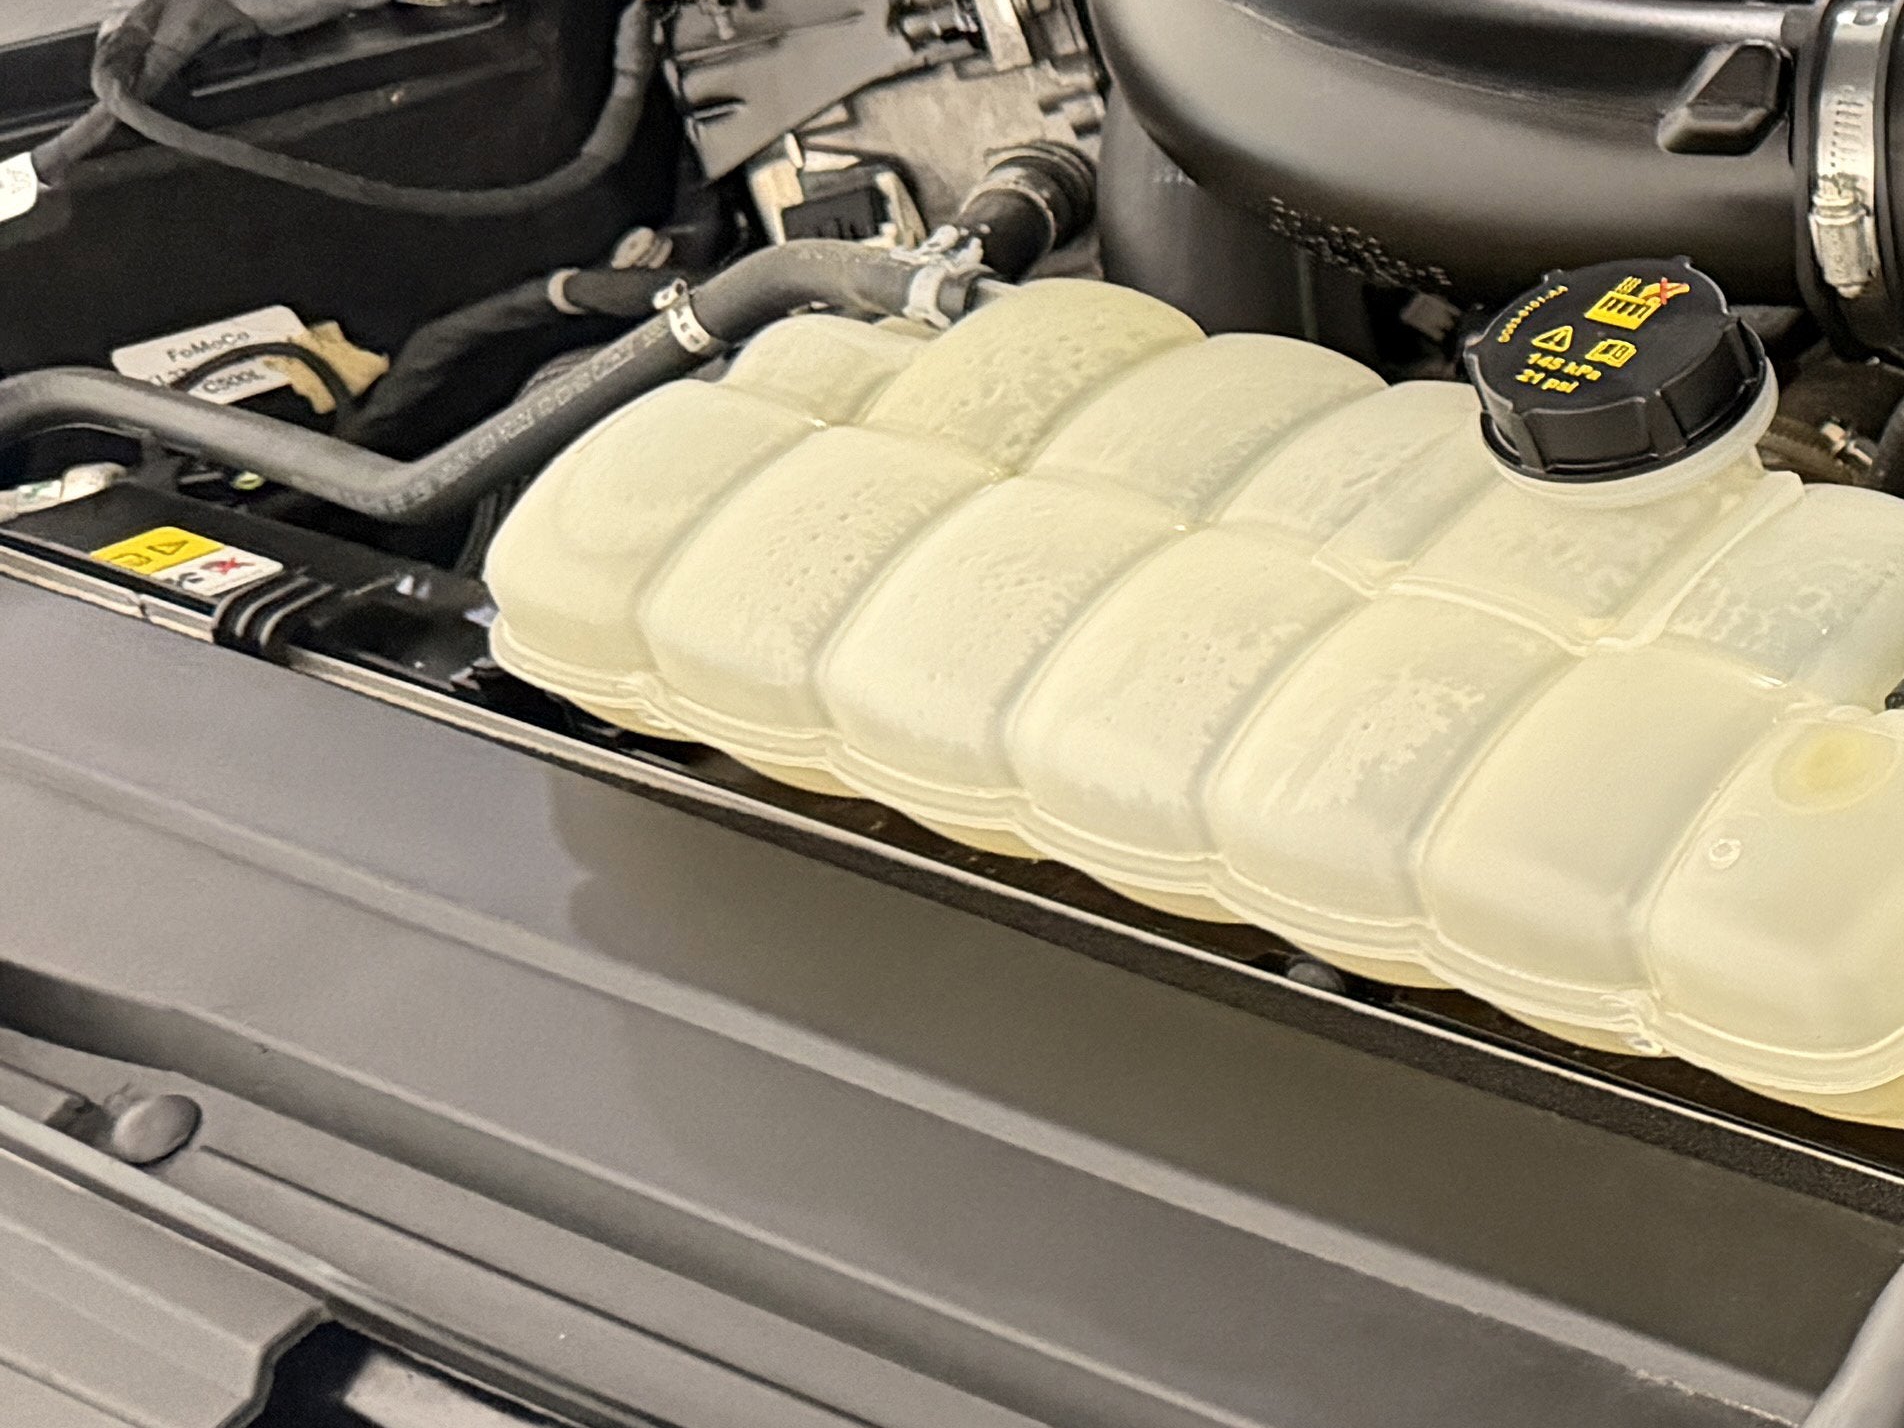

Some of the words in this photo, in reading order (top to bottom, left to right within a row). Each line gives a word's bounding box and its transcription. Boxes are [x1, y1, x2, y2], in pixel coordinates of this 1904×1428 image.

[165, 331, 251, 362] FoMoCo
[1514, 368, 1546, 385] 21
[1541, 377, 1580, 393] psi
[1526, 352, 1566, 371] 145
[1561, 360, 1603, 382] kPa
